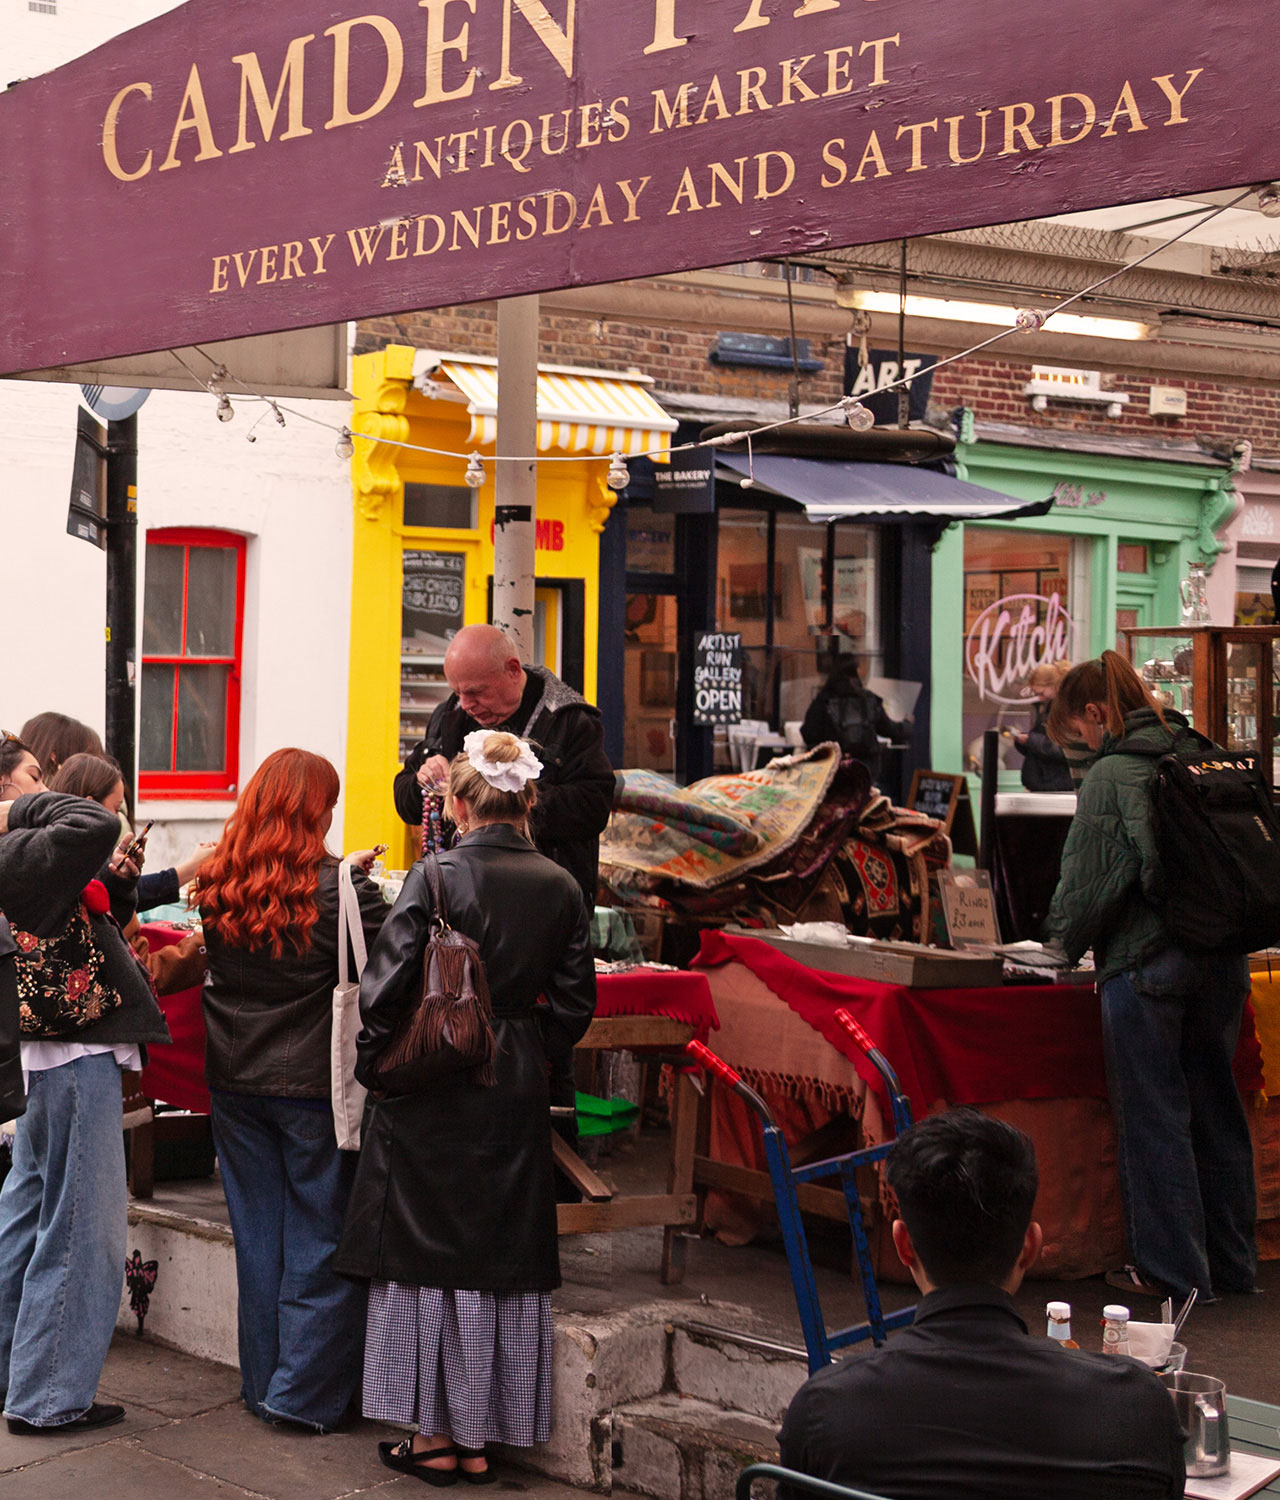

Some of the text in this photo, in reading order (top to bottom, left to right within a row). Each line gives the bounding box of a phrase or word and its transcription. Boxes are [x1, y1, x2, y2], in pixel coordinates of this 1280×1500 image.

[101, 0, 577, 182] CAMDEN
[382, 33, 901, 188] ANTIQUES MARKET
[209, 68, 1205, 294] EVERY WEDNESDAY AND SATURDAY
[850, 358, 922, 396] ART
[654, 469, 711, 482] THE BAKERY
[698, 633, 741, 650] ARTIST
[974, 592, 1069, 701] Kitch
[706, 651, 732, 666] RUN
[694, 665, 742, 683] GALLERY
[696, 689, 742, 711] OPEN
